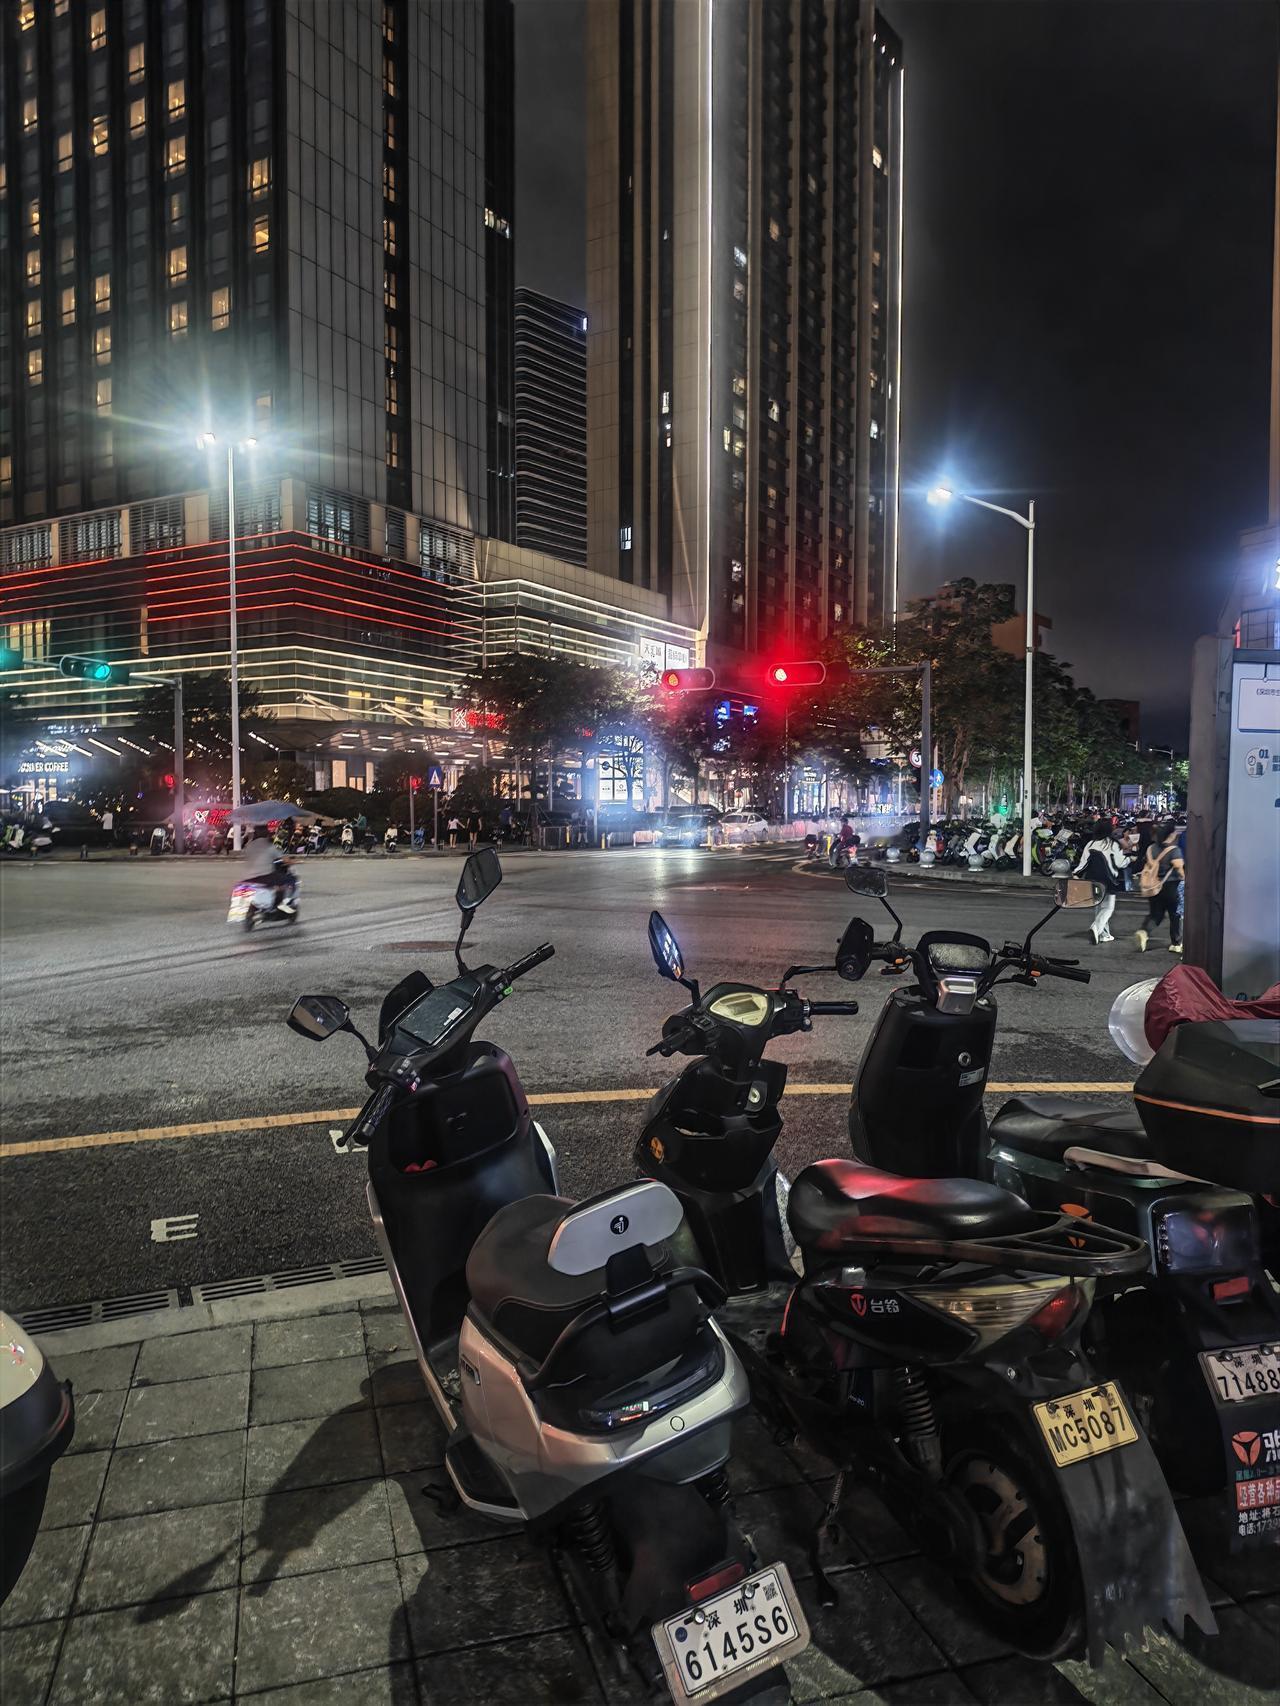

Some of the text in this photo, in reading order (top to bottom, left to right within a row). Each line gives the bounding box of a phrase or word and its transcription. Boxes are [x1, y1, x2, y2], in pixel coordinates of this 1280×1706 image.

[44, 762, 69, 773] COFFEE
[1259, 749, 1269, 759] 01
[1217, 1367, 1280, 1398] 71488
[1063, 1397, 1096, 1419] 深圳
[1048, 1405, 1126, 1453] MC5087
[705, 1598, 750, 1631] 深圳
[685, 1606, 789, 1681] 6145S6
